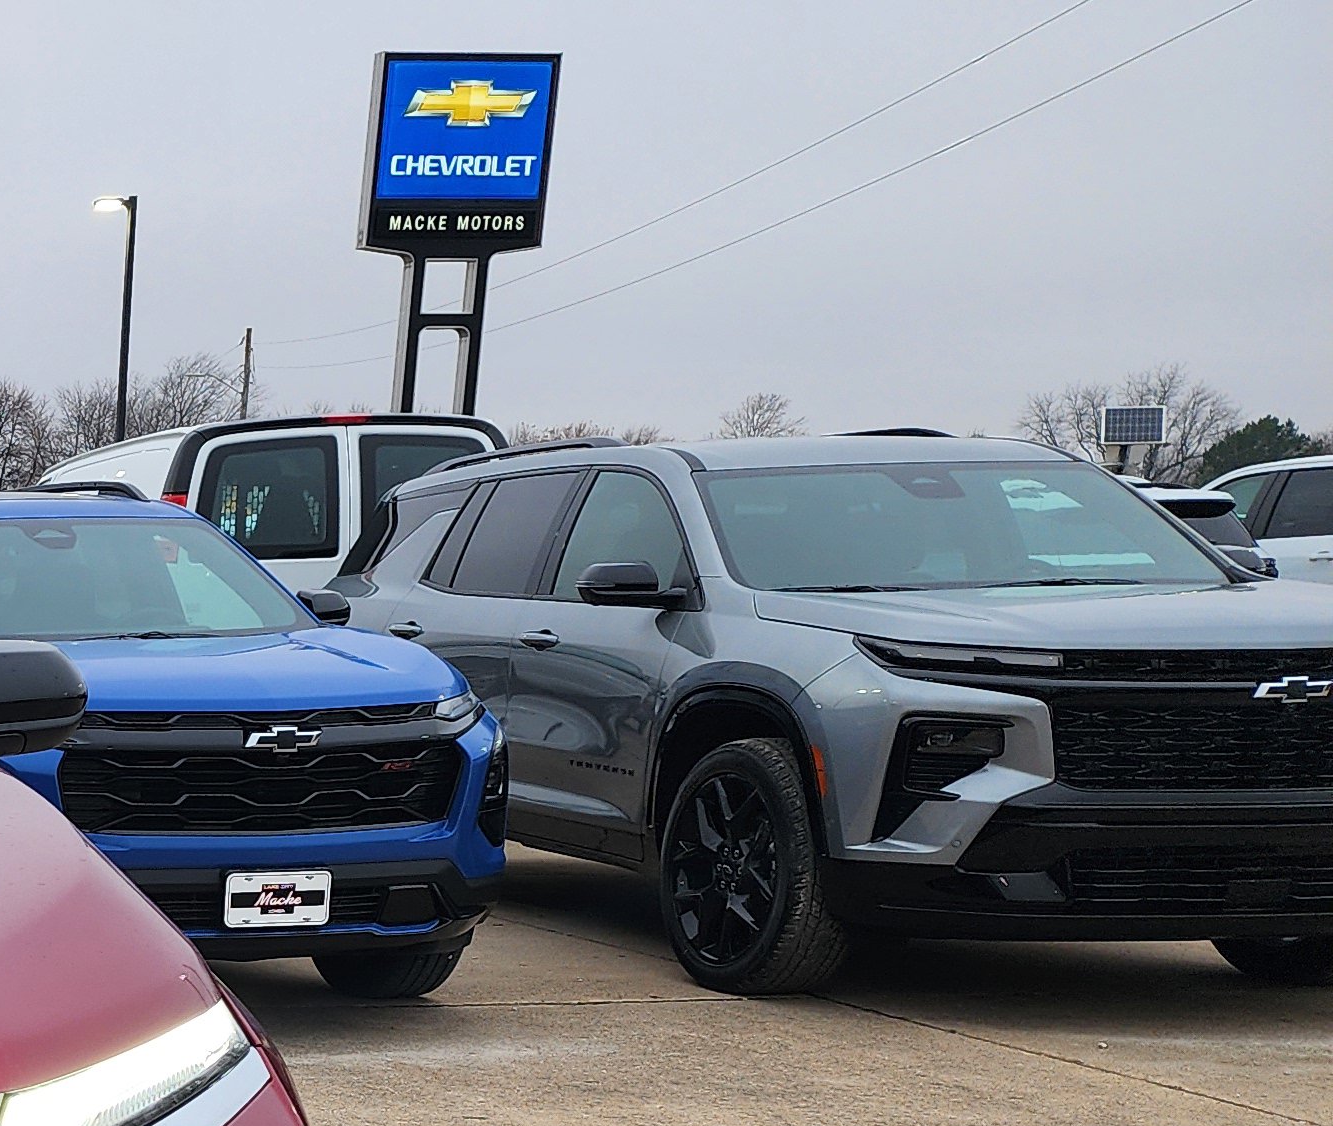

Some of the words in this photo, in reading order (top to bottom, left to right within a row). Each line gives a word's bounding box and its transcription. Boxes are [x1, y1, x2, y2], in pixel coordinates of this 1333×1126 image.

[390, 154, 538, 177] CHEVROLET
[388, 215, 448, 231] MACKE
[456, 215, 526, 231] MOTORS
[253, 891, 302, 907] Macke
